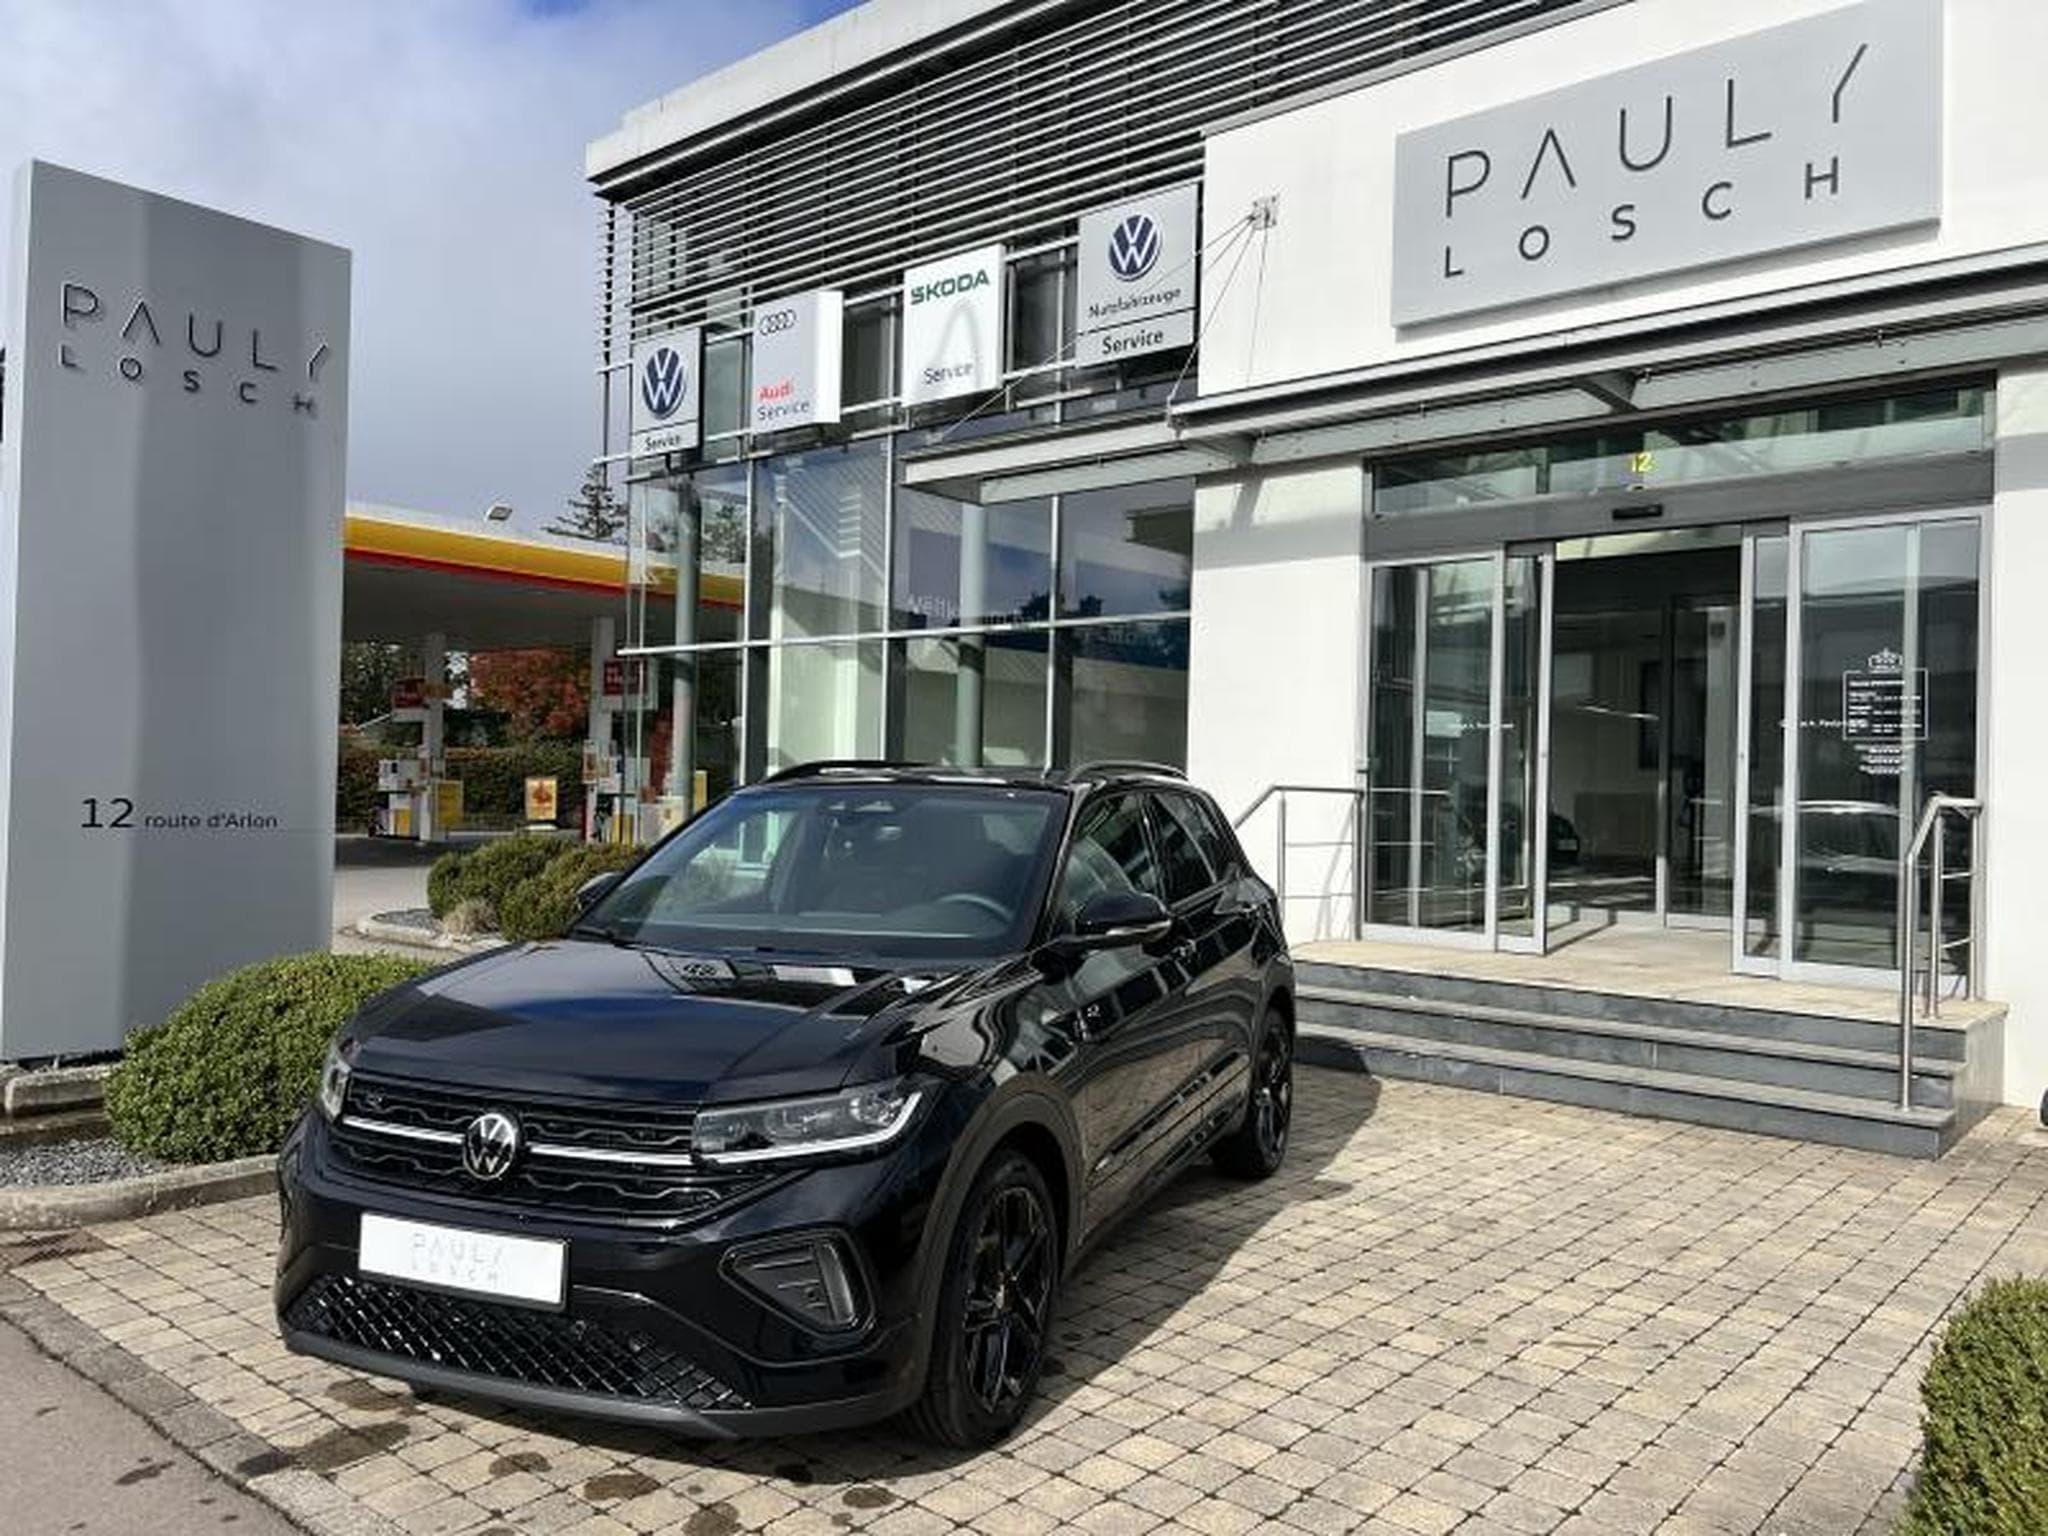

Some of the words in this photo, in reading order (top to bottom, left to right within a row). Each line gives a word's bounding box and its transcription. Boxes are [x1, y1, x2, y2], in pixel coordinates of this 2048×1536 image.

[1446, 44, 1868, 217] PAULY
[1443, 156, 1838, 278] LOSCH
[62, 282, 328, 380] PAULY
[1102, 329, 1164, 355] Service
[60, 344, 317, 417] LOSCH
[923, 362, 976, 386] Service
[759, 381, 793, 401] Audi
[757, 402, 810, 421] Service
[644, 434, 681, 452] Service
[1632, 452, 1653, 472] 12
[81, 798, 136, 828] 12
[145, 814, 201, 828] route
[206, 812, 278, 829] d'Arlon
